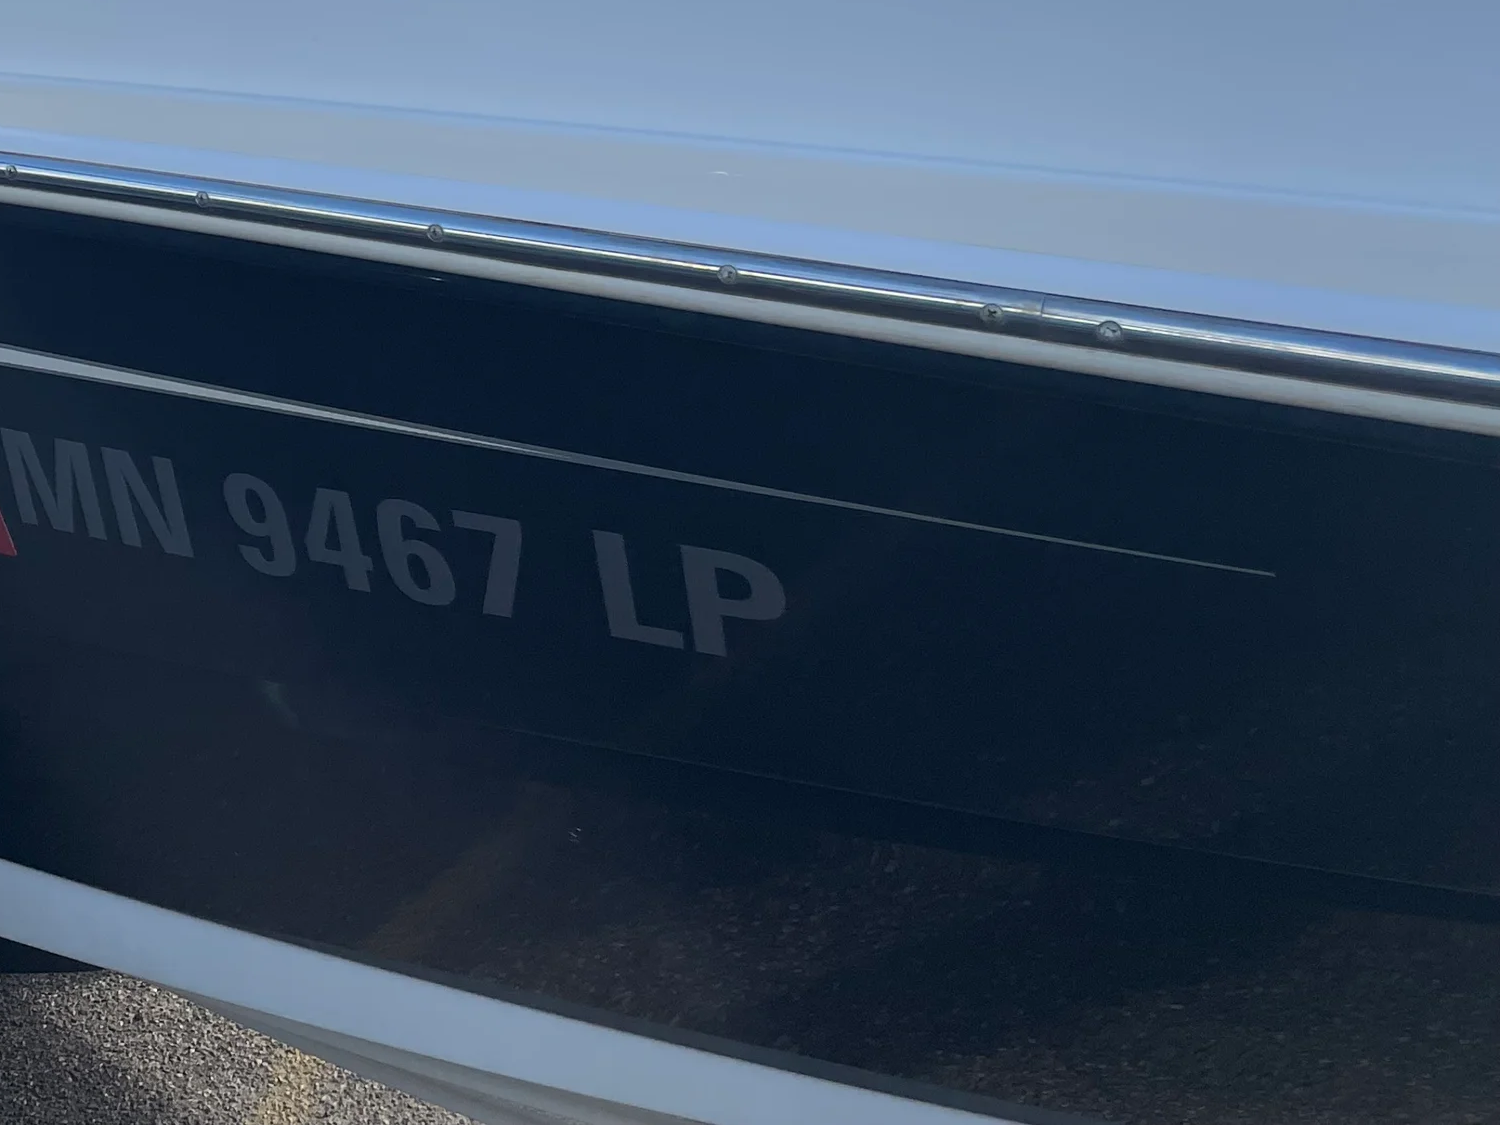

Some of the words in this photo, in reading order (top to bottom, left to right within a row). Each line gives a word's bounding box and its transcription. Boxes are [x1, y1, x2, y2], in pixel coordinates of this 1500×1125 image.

[0, 426, 195, 557] MN
[222, 472, 522, 618] 9467
[593, 529, 787, 657] LP
